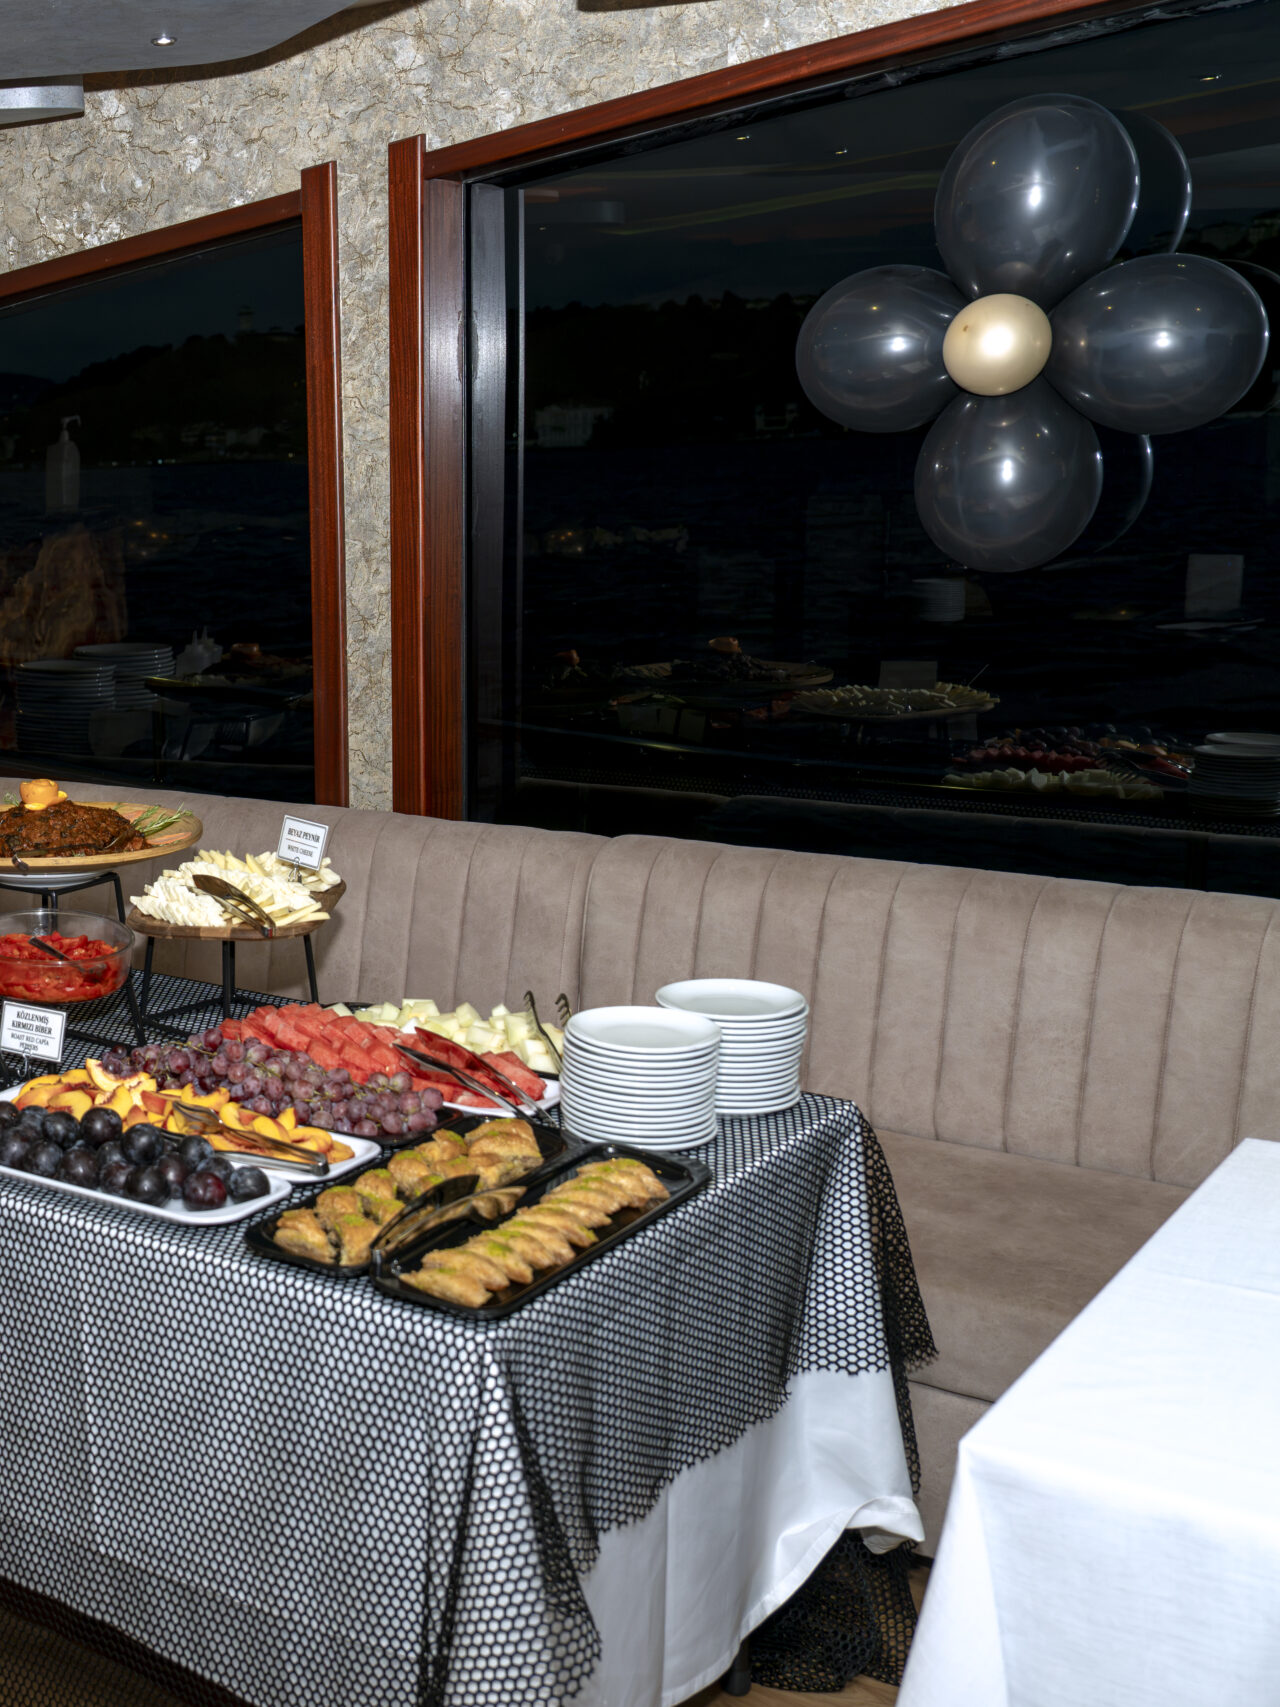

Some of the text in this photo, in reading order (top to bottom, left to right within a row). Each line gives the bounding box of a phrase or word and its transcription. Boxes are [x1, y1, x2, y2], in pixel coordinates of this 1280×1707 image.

[16, 1010, 49, 1025] KÖZLENMİŞ
[11, 1020, 53, 1035] KIRMIZI BİBER
